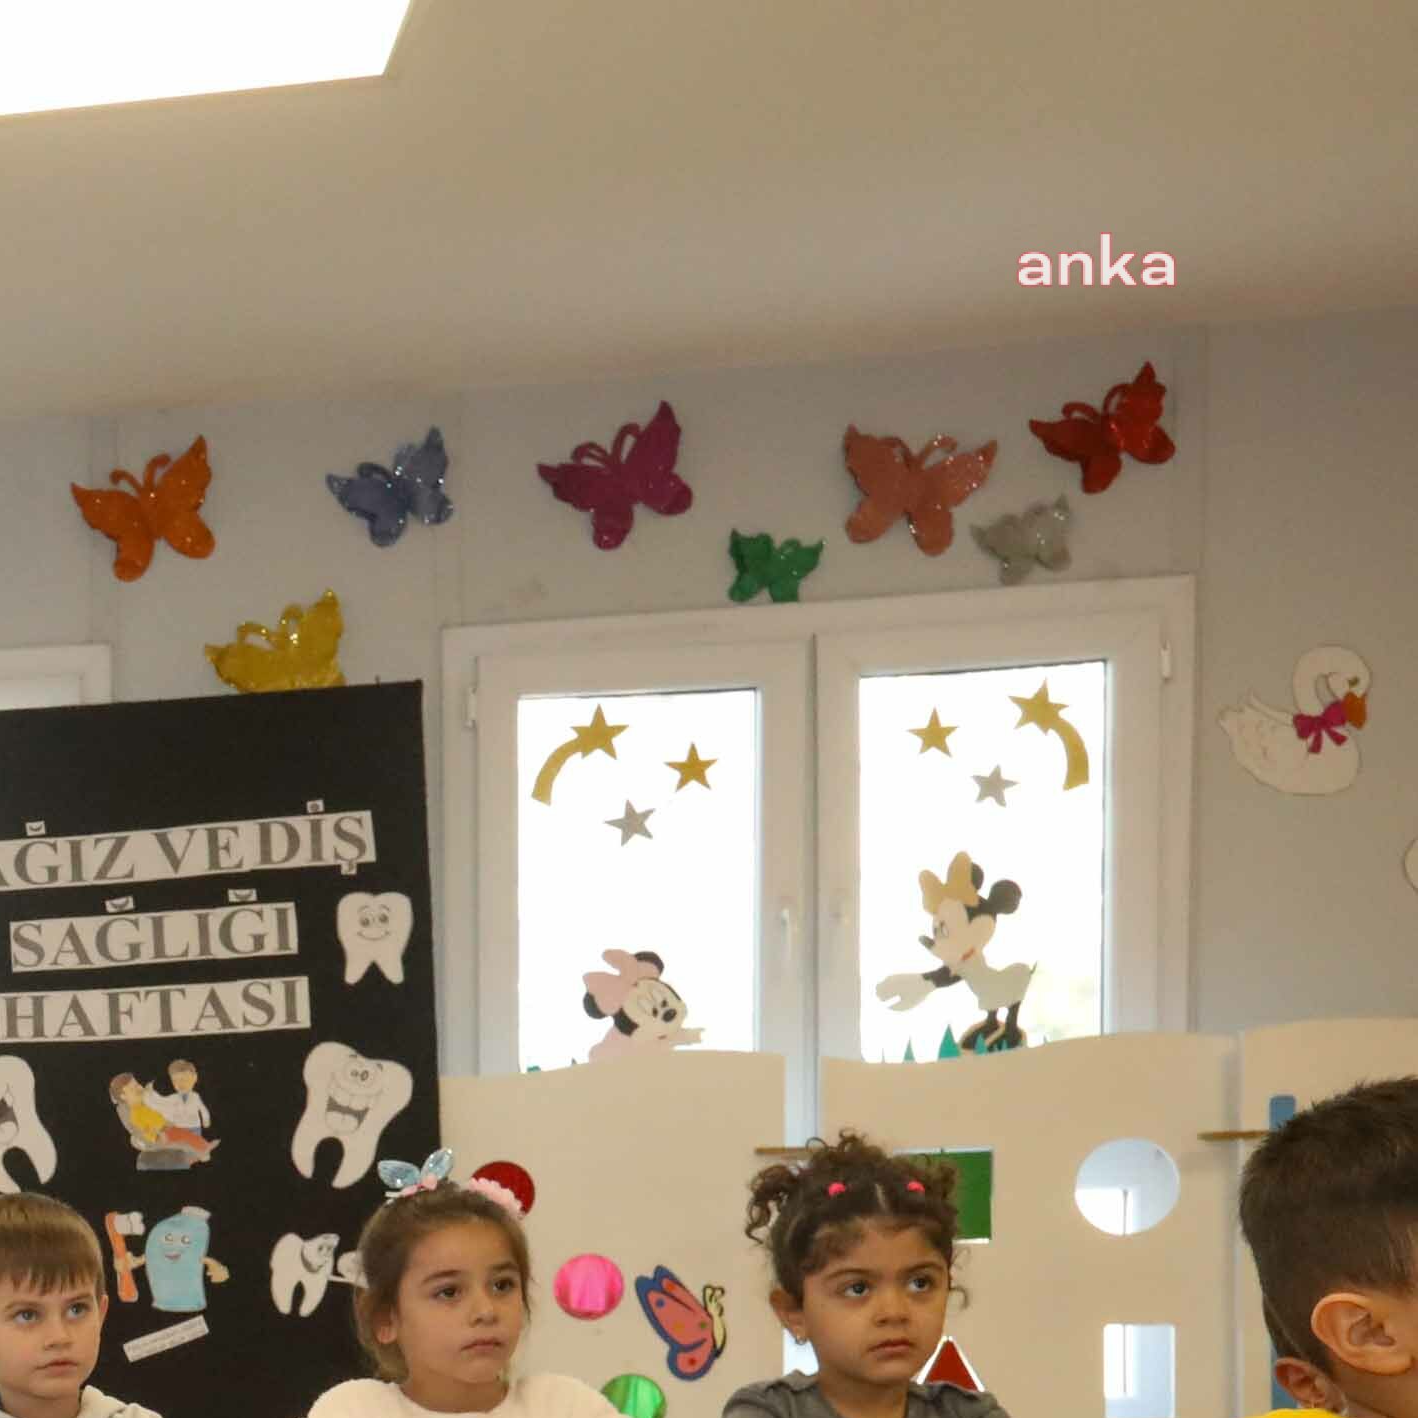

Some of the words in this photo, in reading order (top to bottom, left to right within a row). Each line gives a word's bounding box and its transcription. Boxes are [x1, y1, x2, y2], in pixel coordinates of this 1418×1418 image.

[152, 825, 246, 875] VE
[257, 801, 369, 874] DİŞ
[11, 892, 295, 967] SAĞLIĞI
[1, 979, 304, 1040] HAFTASI
